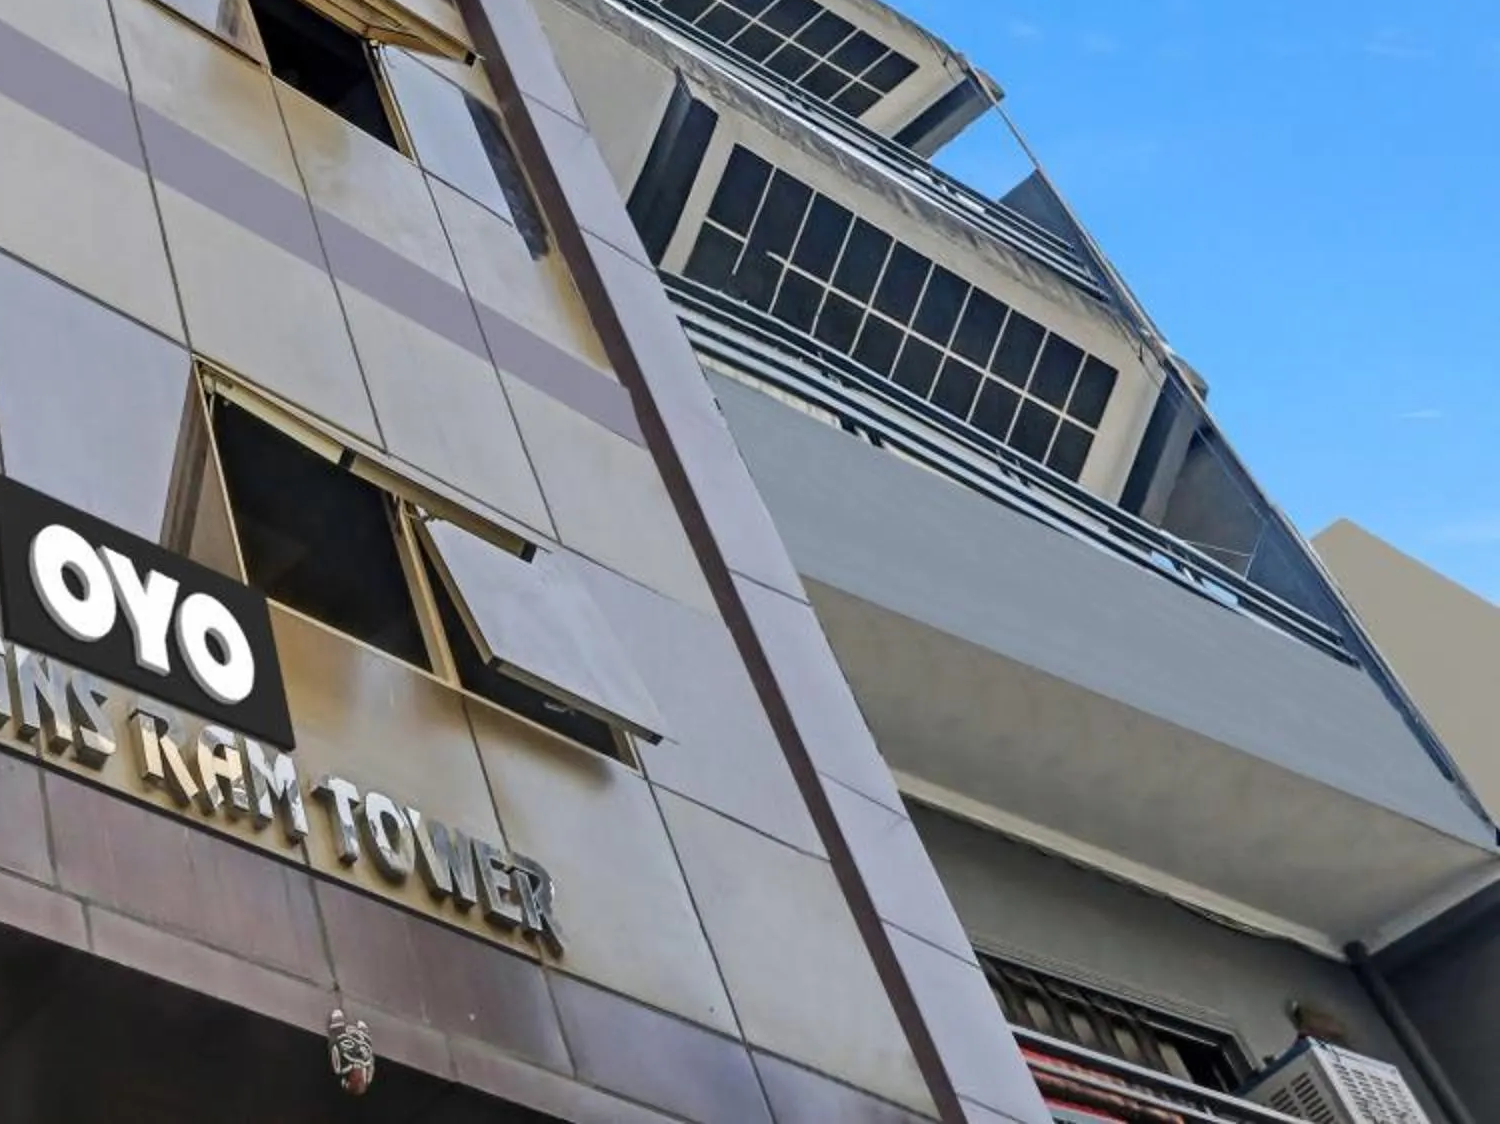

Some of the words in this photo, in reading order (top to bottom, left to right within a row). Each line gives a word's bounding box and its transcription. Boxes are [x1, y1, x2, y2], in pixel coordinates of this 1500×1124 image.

[29, 524, 255, 705] OYO
[130, 697, 310, 841] RAM
[311, 775, 568, 962] TOWER
